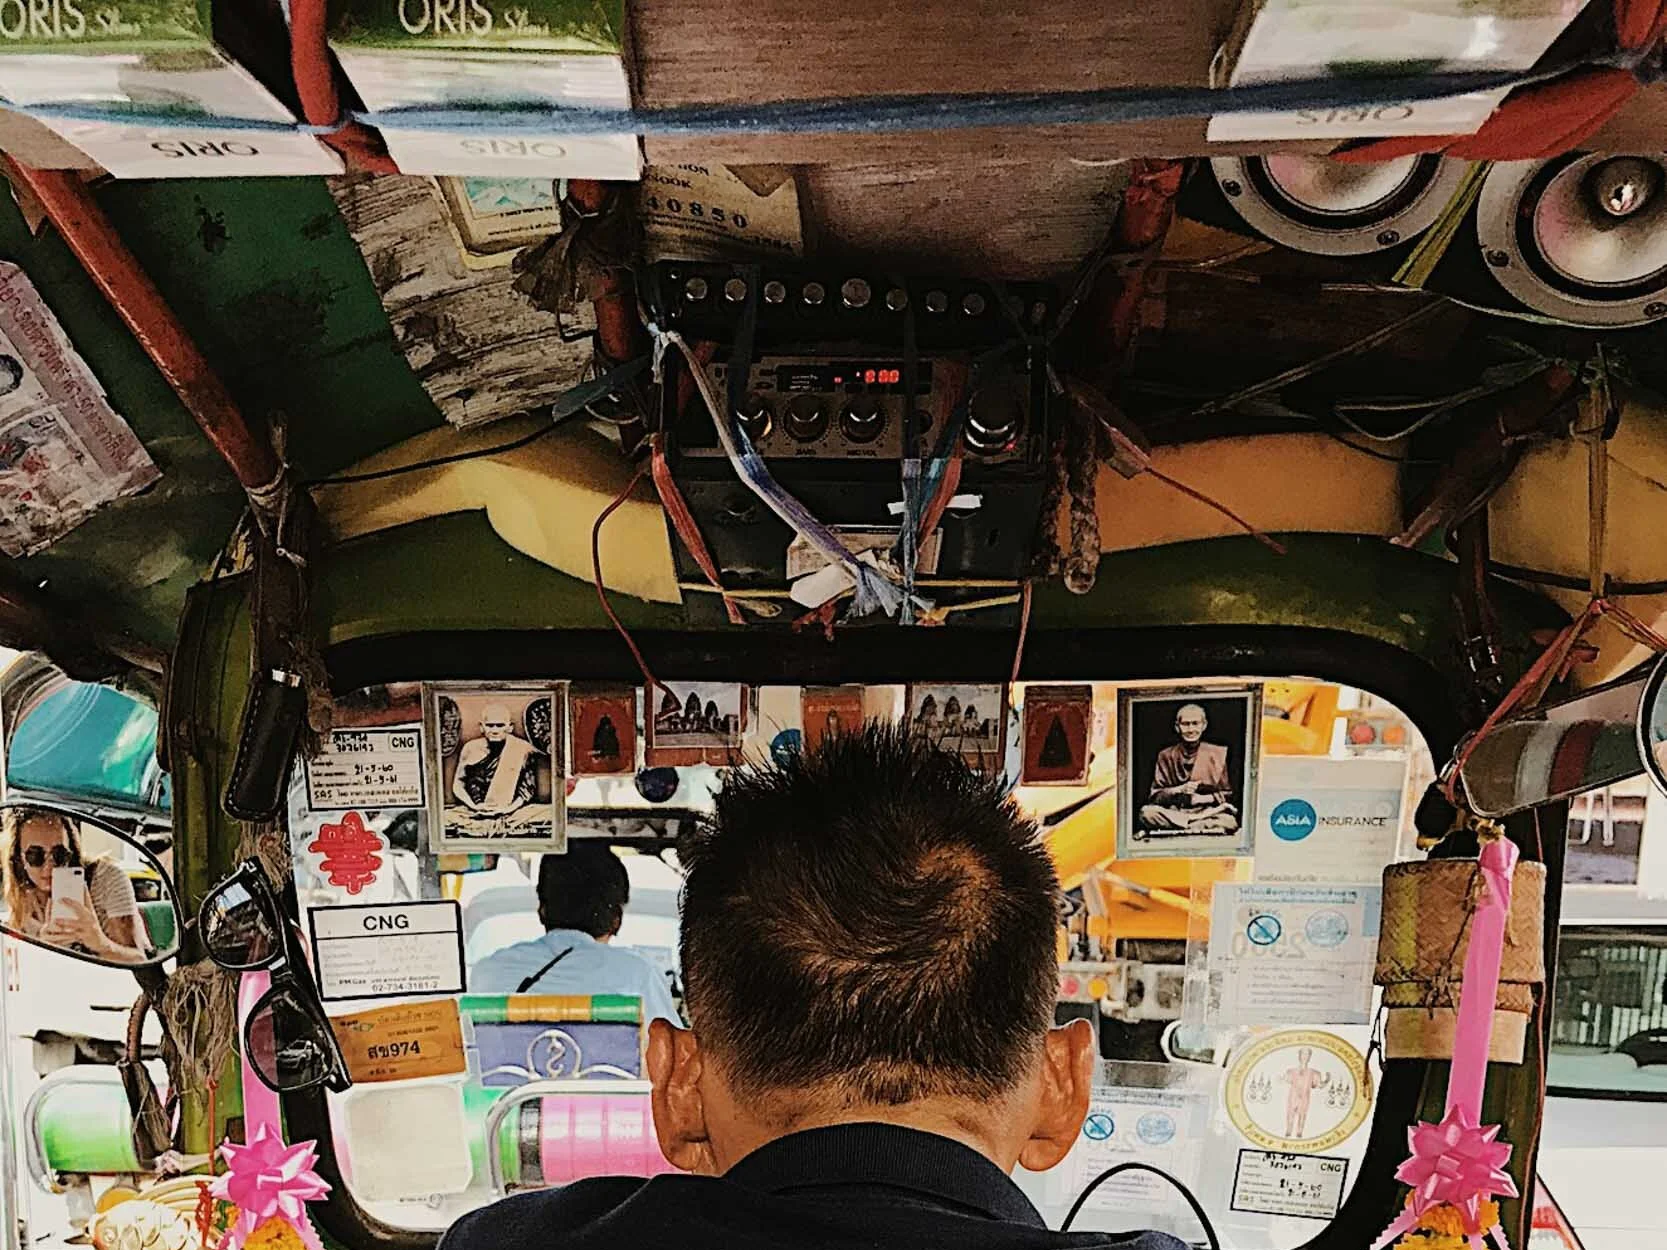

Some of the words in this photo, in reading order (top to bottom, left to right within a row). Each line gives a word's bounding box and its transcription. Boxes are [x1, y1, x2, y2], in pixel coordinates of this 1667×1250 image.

[0, 0, 85, 40] ORIS
[398, 0, 493, 35] ORIS
[151, 141, 259, 158] ORIS
[459, 139, 567, 158] ORIS
[391, 736, 415, 749] CNG
[1274, 814, 1312, 826] ASIA
[1318, 816, 1387, 827] INSURANCE
[363, 914, 410, 931] CNG
[1320, 1162, 1341, 1173] CNG
